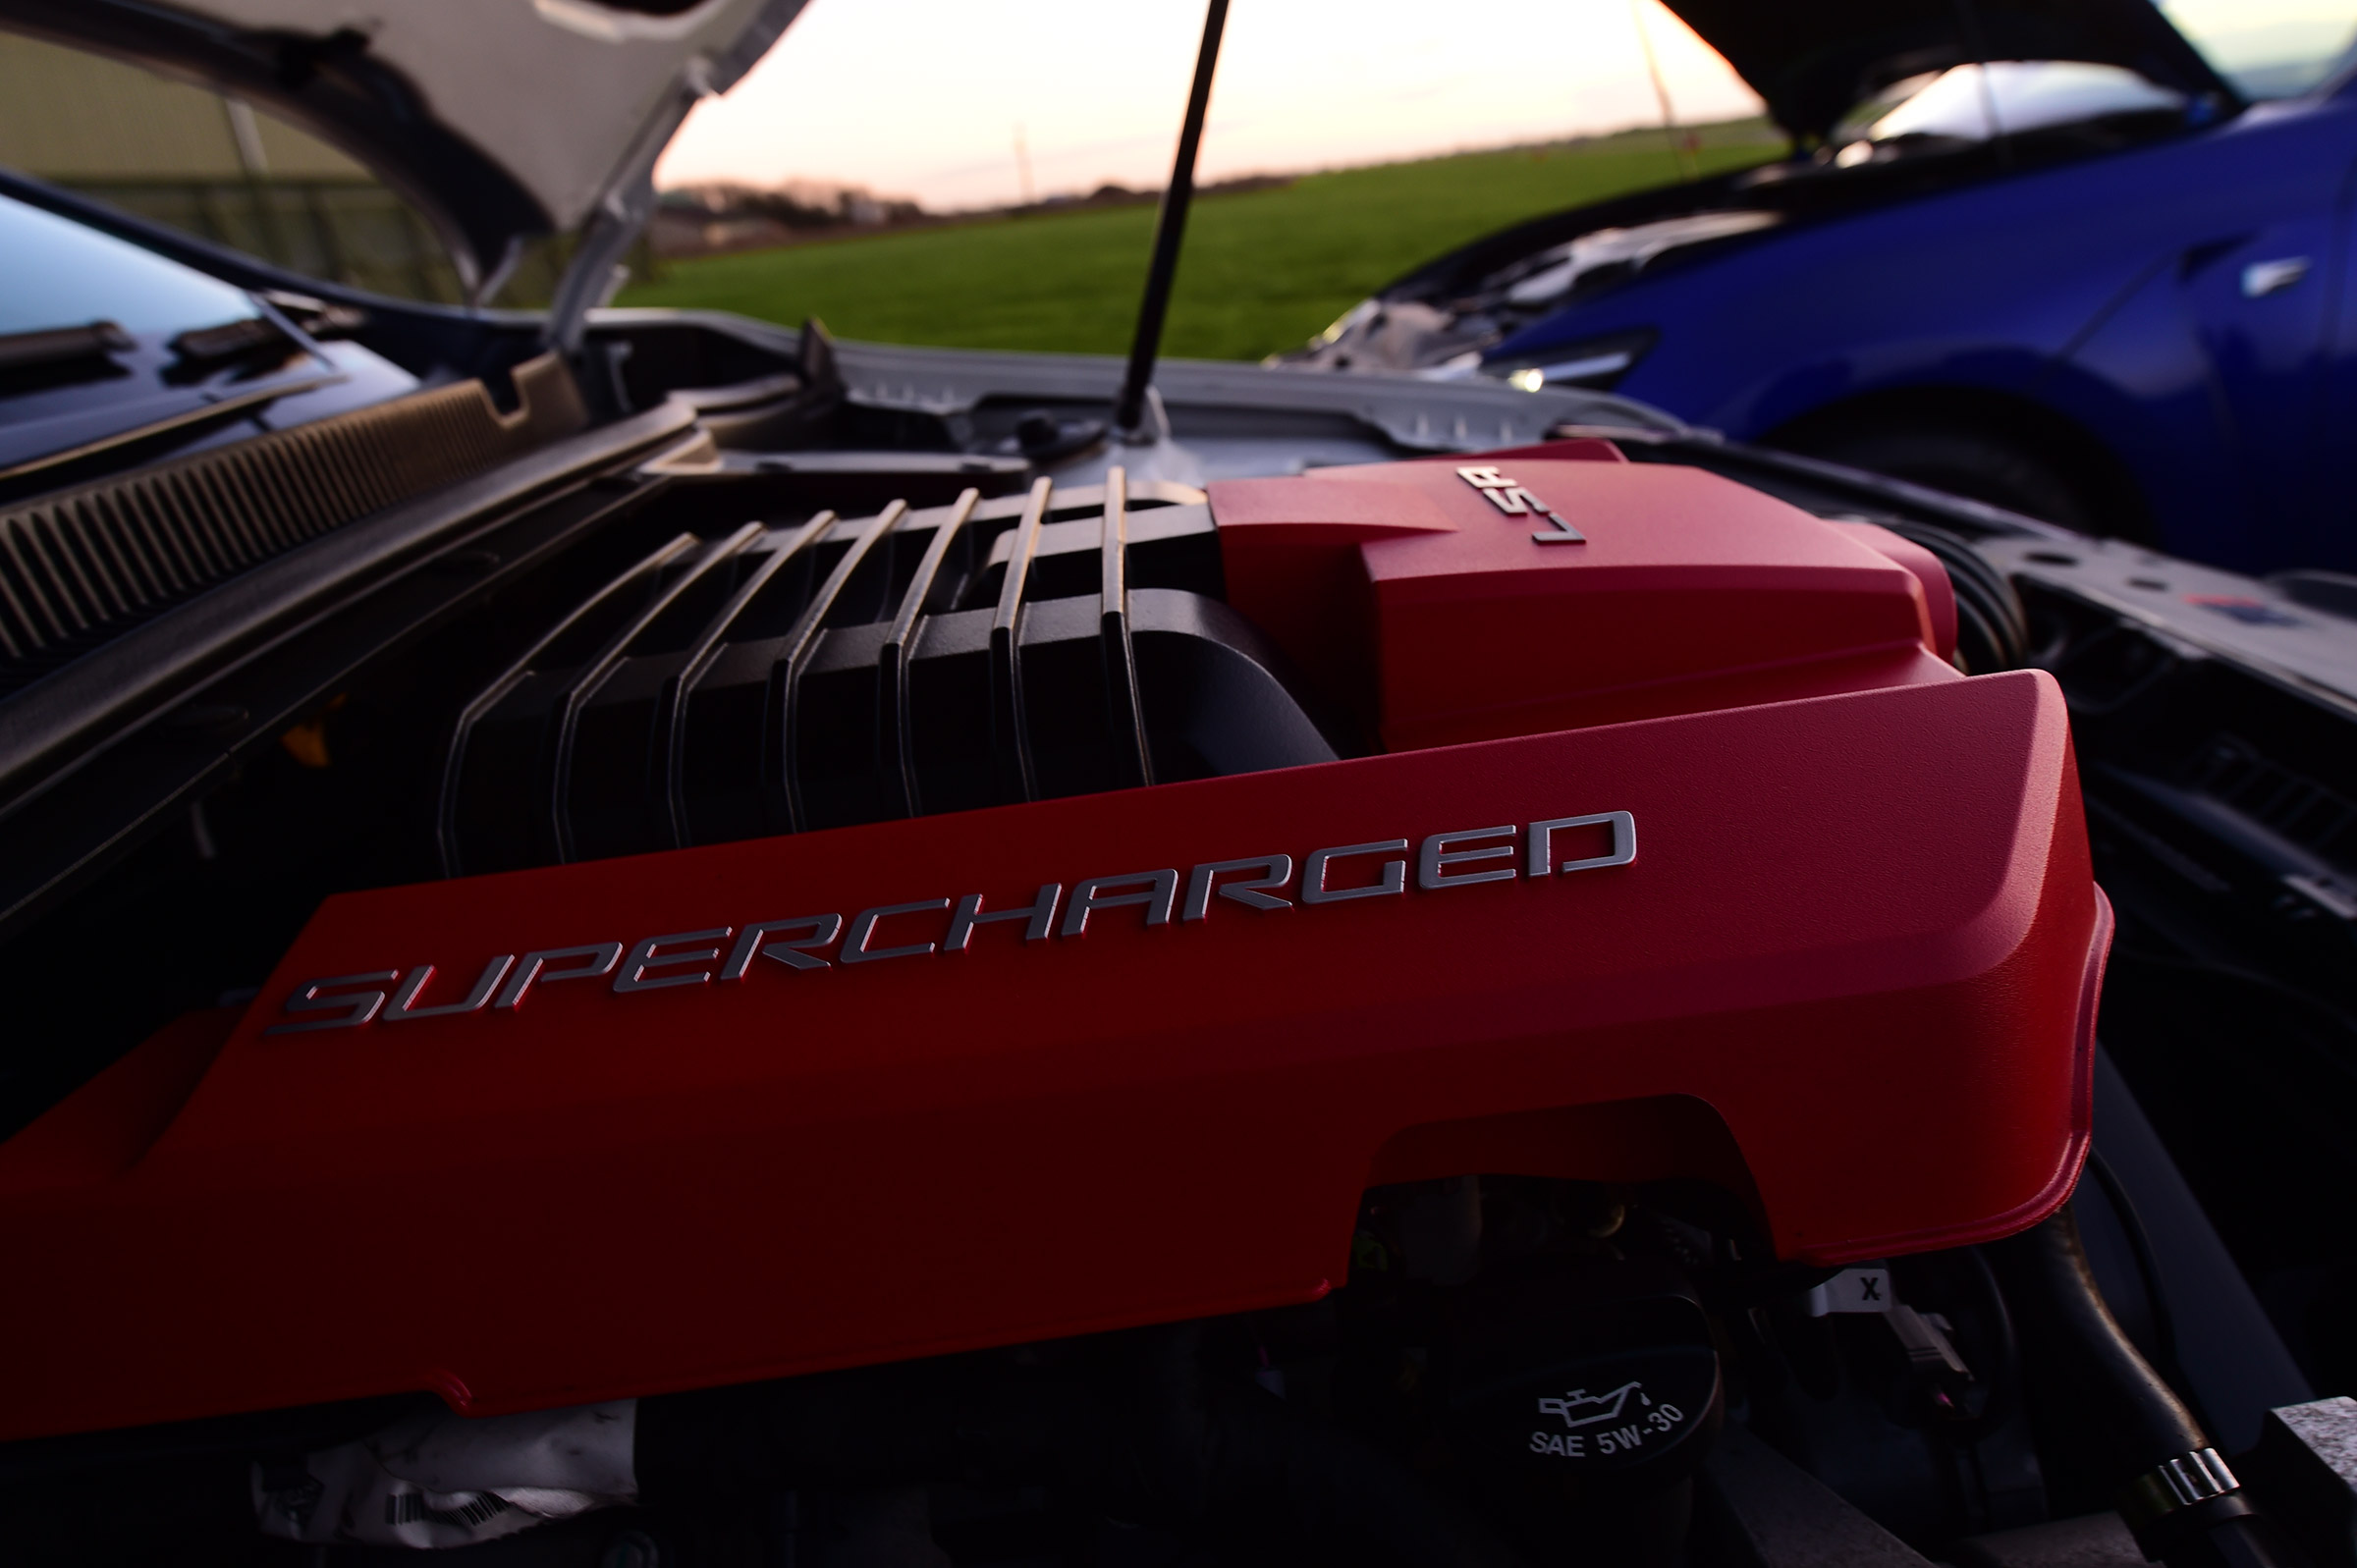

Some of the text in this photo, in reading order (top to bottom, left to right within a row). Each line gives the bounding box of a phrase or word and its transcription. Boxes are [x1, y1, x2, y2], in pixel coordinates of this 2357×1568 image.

[263, 810, 1637, 1035] SUPERCHARGED
[1860, 1277, 1880, 1301] X
[1528, 1403, 1684, 1458] SAE 5W-30
